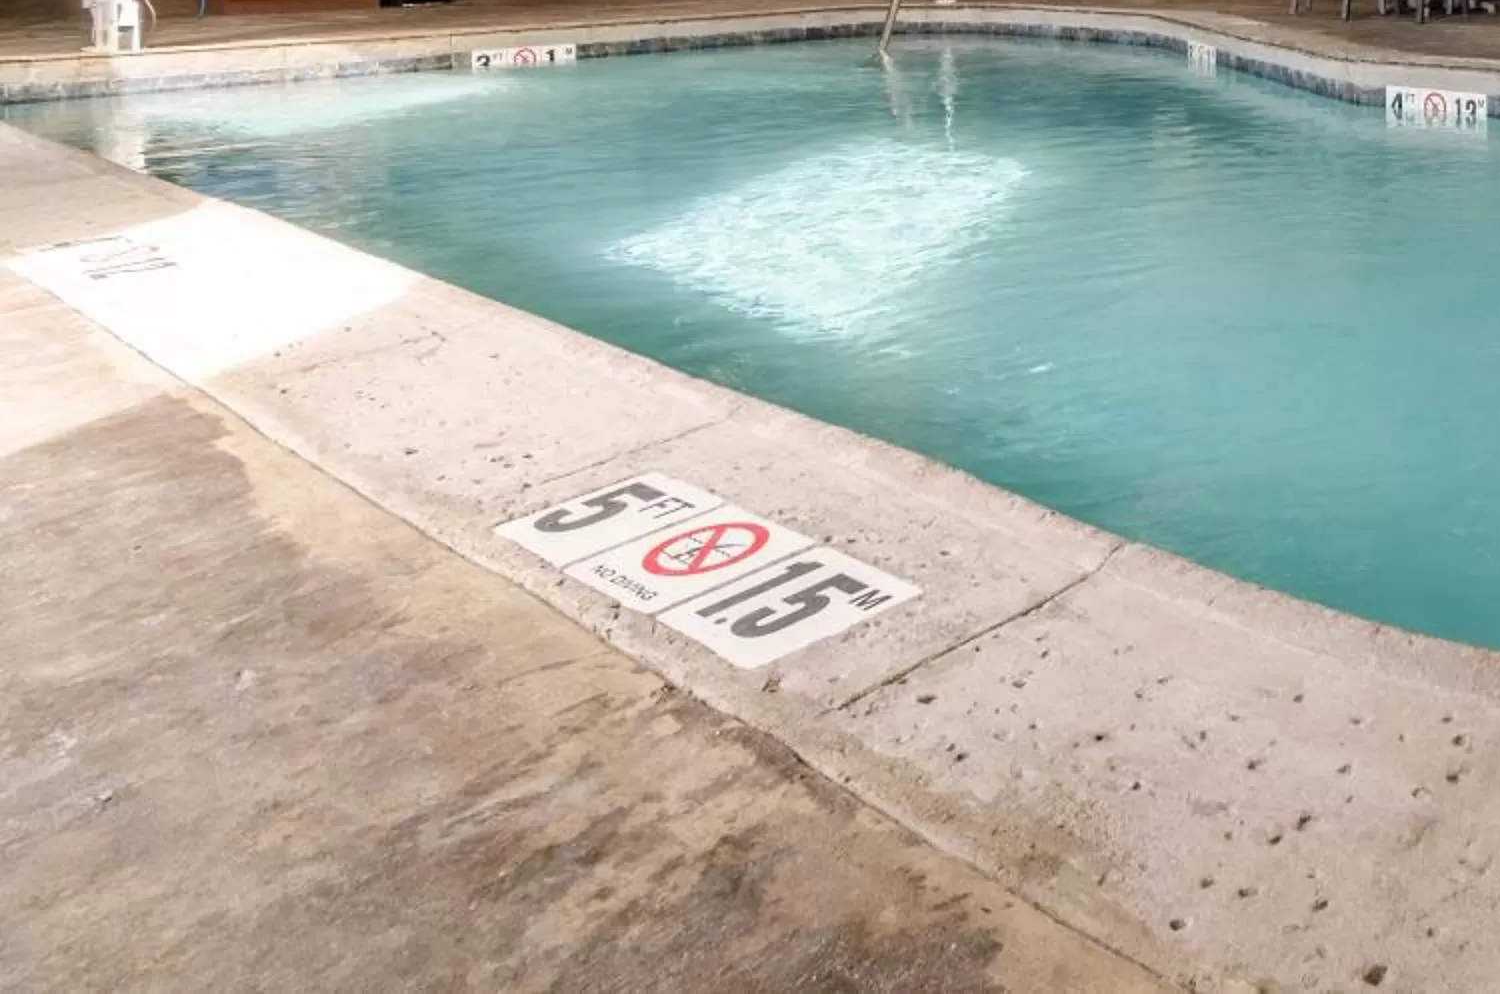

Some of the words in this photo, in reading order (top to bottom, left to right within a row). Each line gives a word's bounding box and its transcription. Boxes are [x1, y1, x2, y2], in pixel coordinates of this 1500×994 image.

[533, 481, 667, 533] 5
[638, 494, 697, 520] FT
[592, 564, 617, 578] NO
[609, 575, 658, 602] DIVING
[695, 560, 871, 639] 1.5
[848, 588, 893, 612] M
